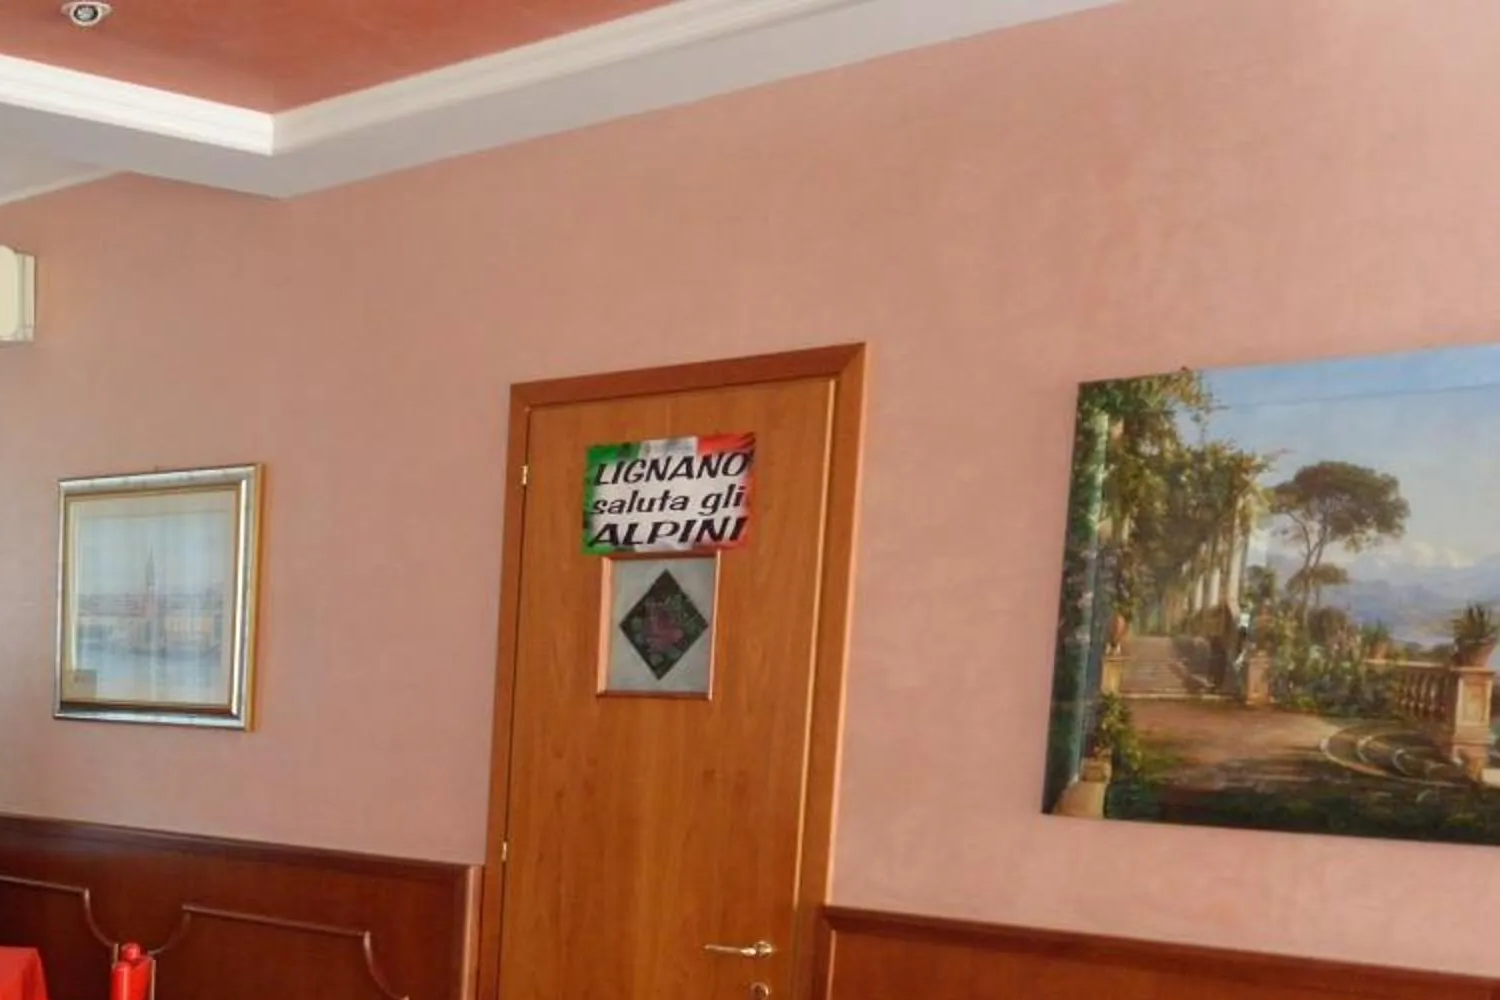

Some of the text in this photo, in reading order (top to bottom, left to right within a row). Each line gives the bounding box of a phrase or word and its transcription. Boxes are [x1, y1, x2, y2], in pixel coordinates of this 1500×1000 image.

[593, 452, 752, 486] LIGNANO
[590, 483, 746, 516] saluta gli
[587, 516, 749, 548] ALPINI
